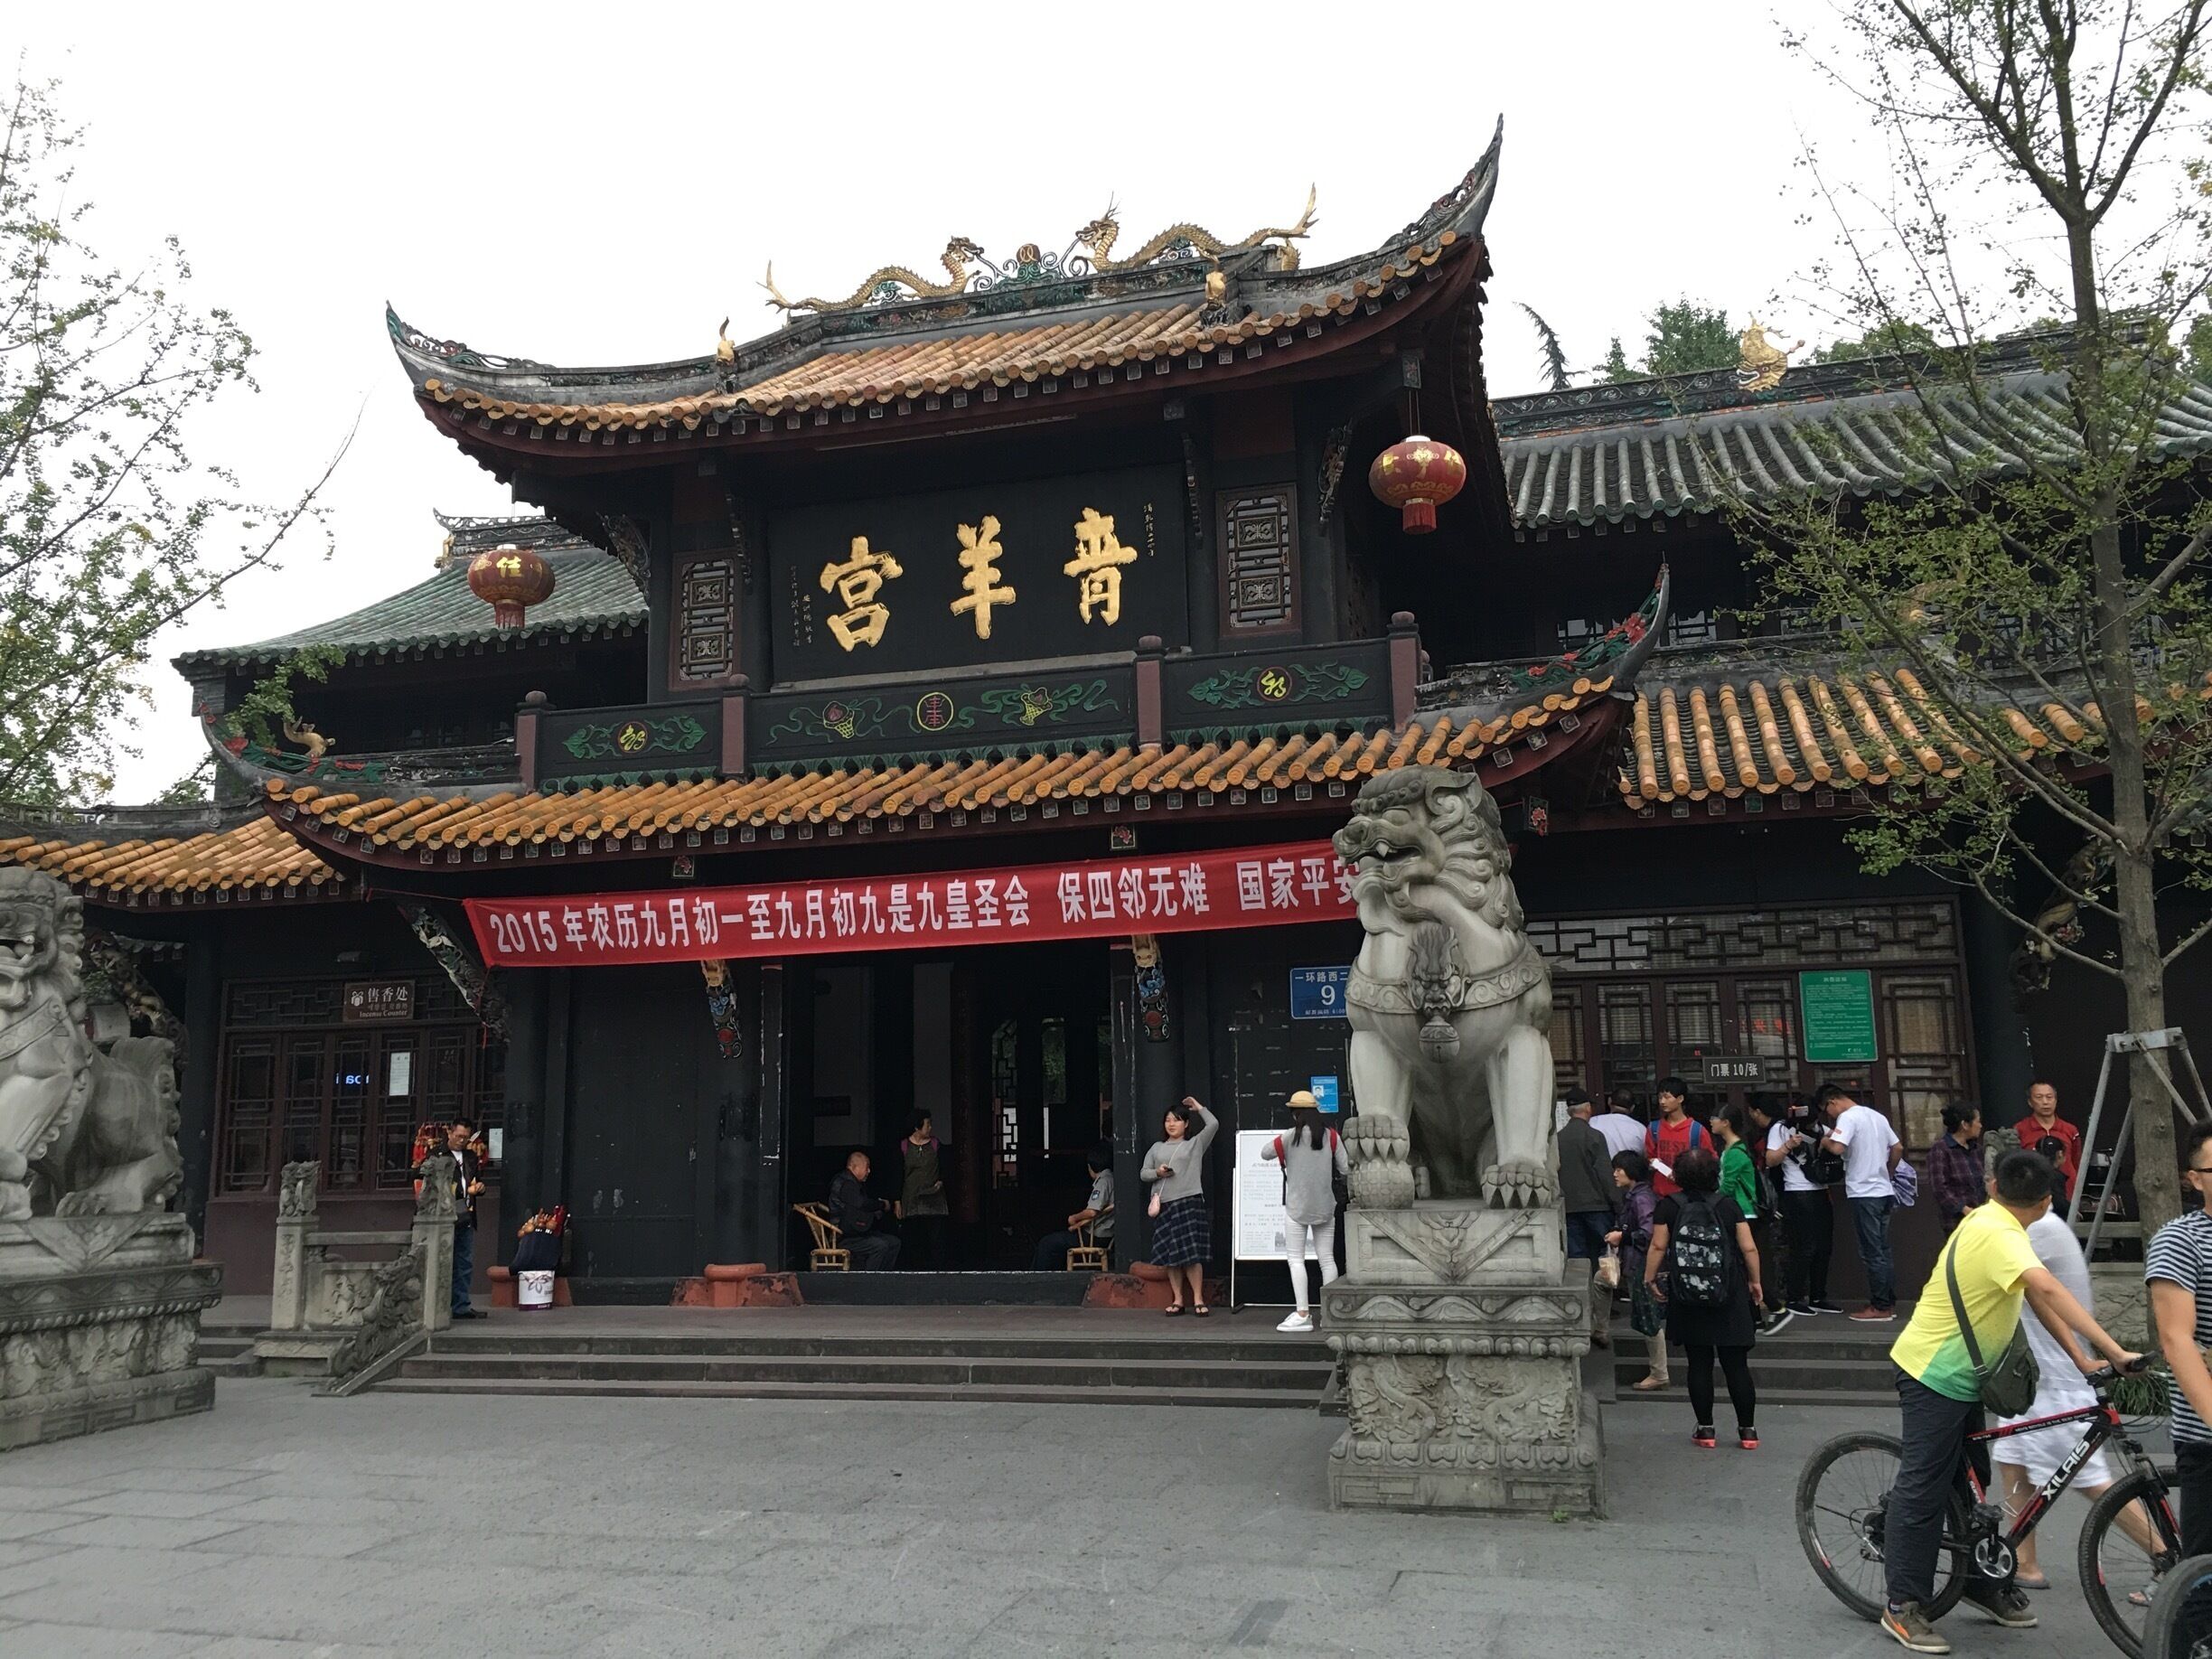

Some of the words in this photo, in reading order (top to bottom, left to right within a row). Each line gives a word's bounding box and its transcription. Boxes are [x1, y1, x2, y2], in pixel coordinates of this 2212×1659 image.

[1056, 862, 1210, 924] 保四邻无难
[1295, 971, 1348, 983] 一环路西二
[368, 986, 408, 1003] 售香处
[1321, 985, 1336, 1006] 9
[1711, 1064, 1730, 1077] 门票
[1733, 1063, 1758, 1077] 10/张
[2040, 1440, 2091, 1502] XILAIS
